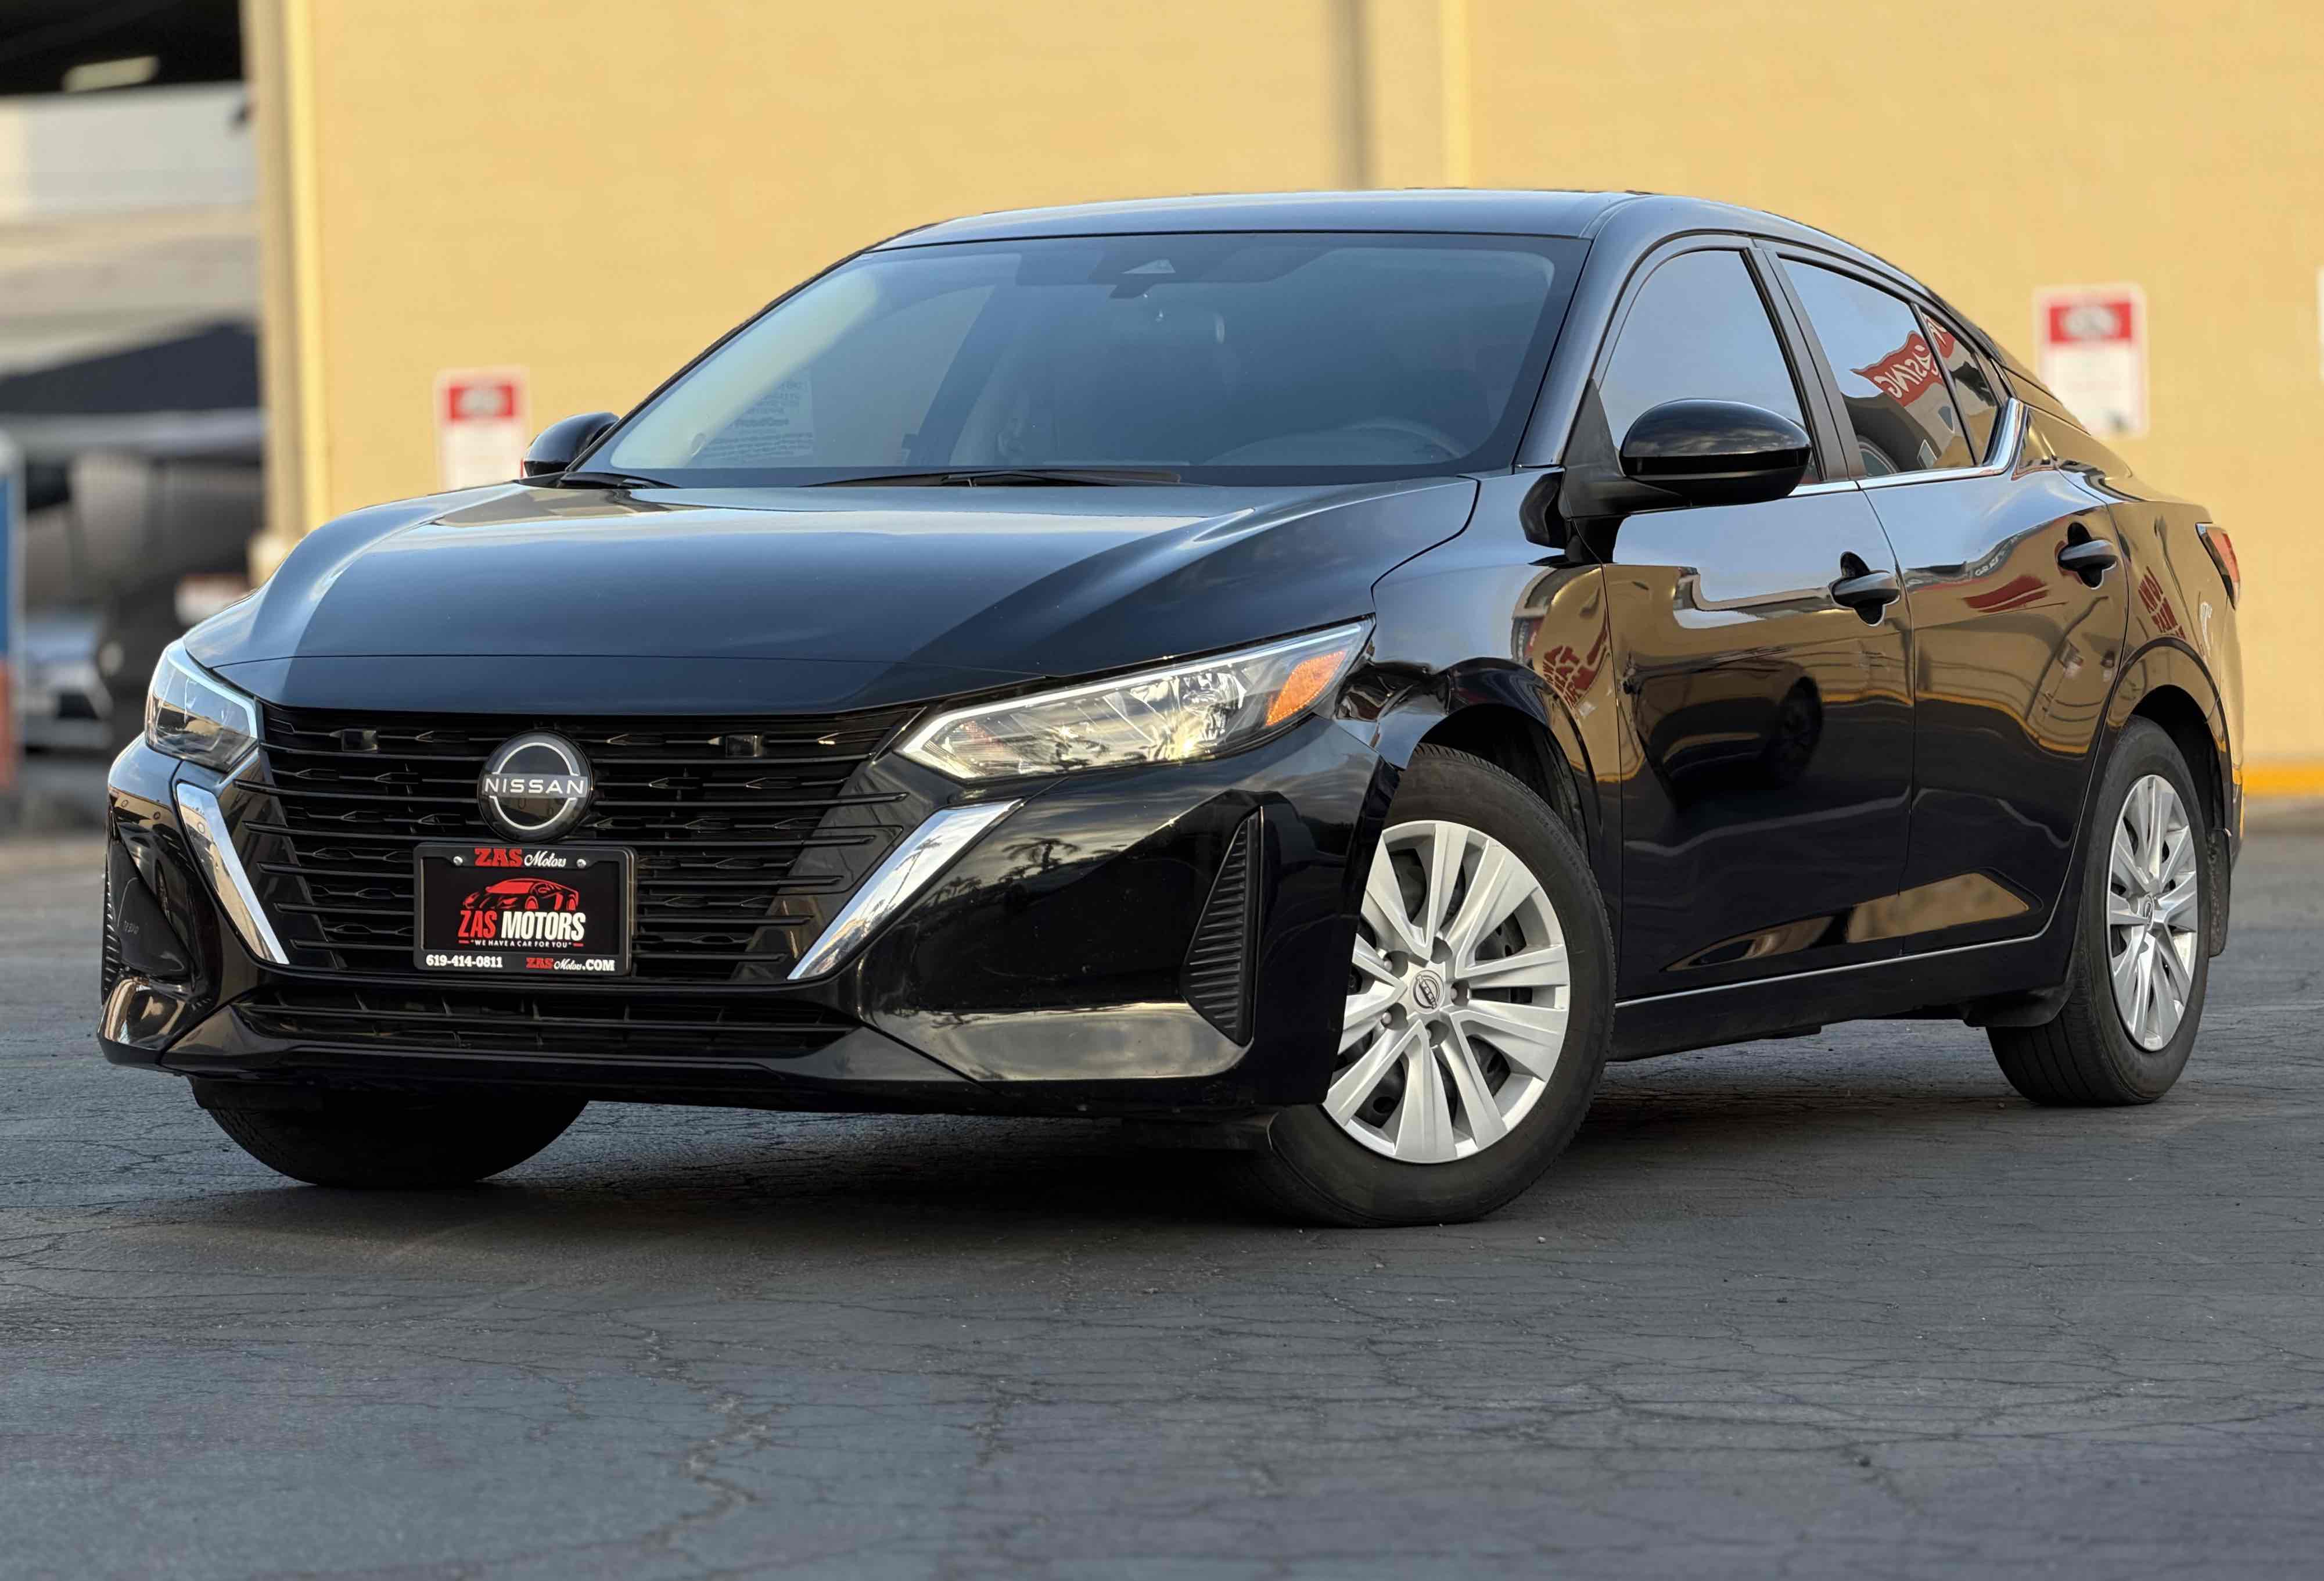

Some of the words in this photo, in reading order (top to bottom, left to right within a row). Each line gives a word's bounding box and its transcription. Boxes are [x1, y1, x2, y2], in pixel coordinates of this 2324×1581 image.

[484, 777, 584, 794] NISSAN
[474, 848, 522, 867] ZAS
[524, 851, 566, 867] Motors
[458, 910, 497, 938] ZAS
[501, 910, 586, 941] MOTORS
[426, 954, 503, 969] 619-414-0811
